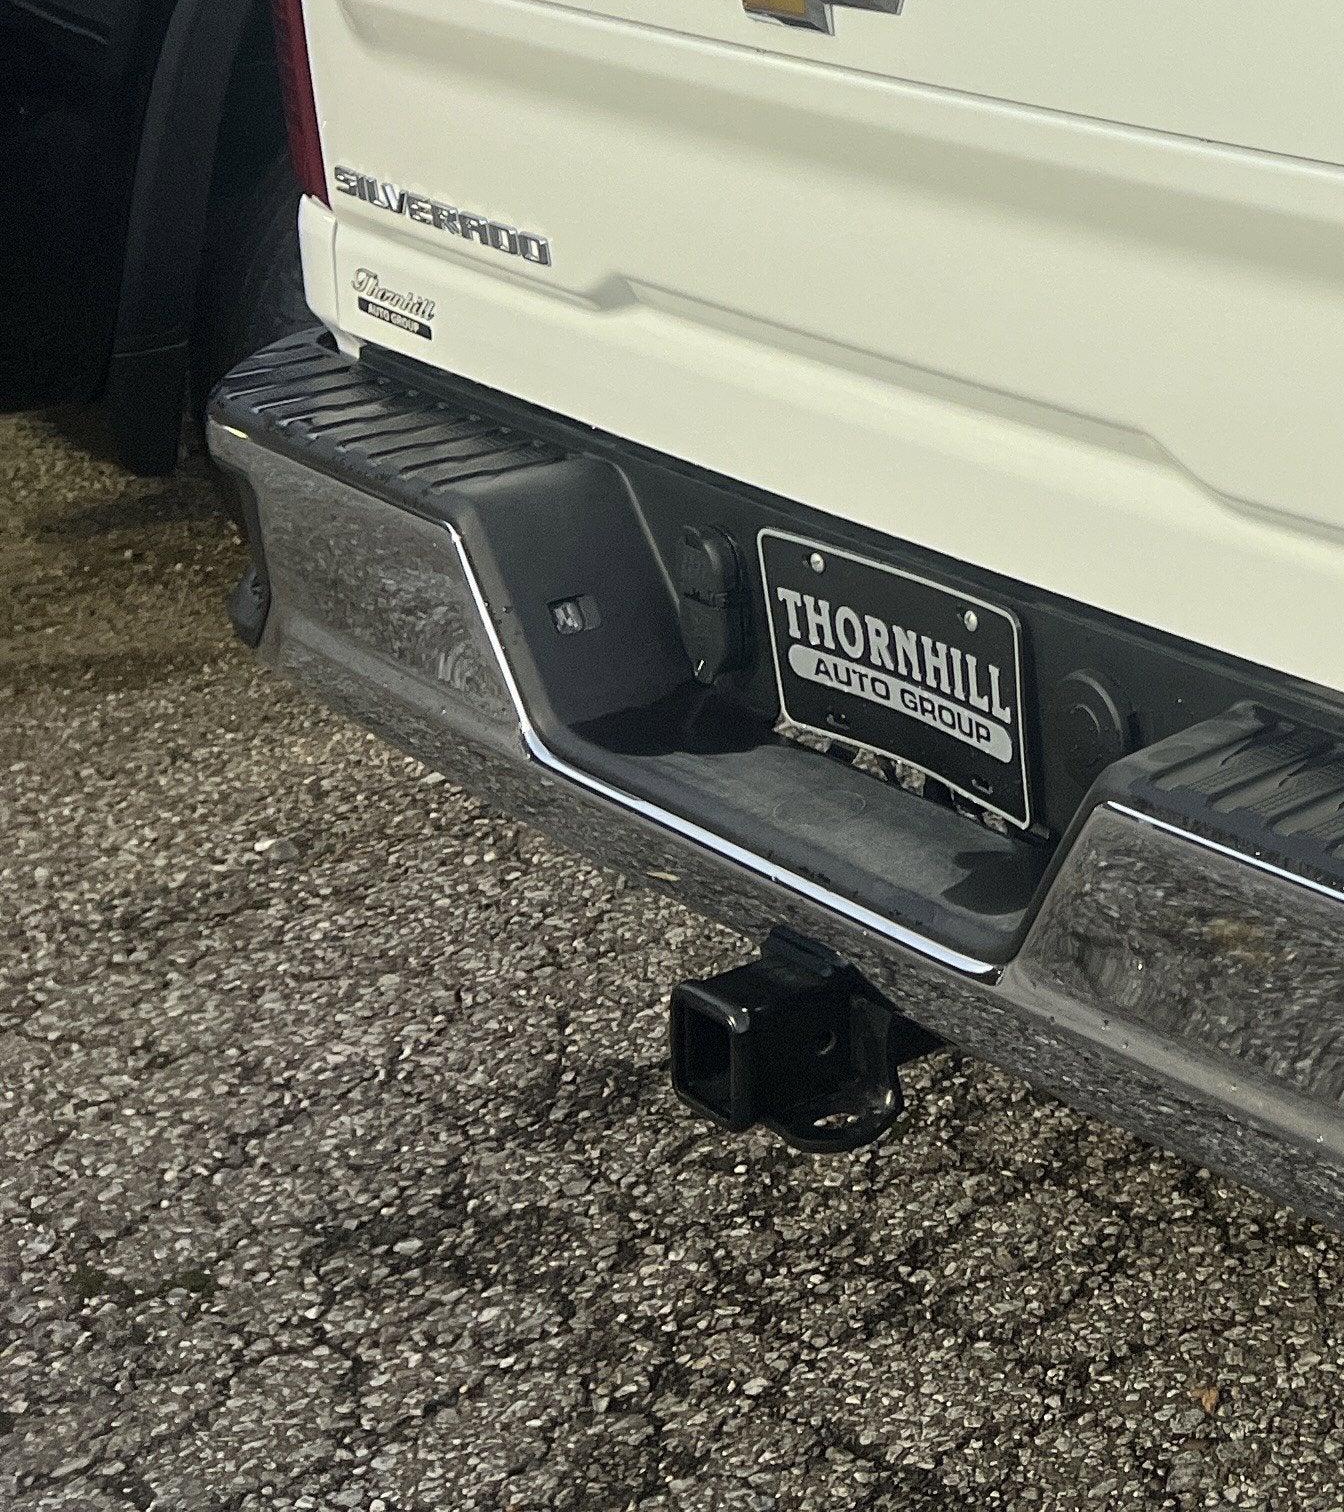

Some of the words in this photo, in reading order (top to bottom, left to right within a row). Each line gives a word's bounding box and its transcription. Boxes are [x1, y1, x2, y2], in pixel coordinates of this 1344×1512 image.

[334, 165, 552, 267] SILVERADO
[351, 268, 436, 321] Thornhill
[367, 303, 390, 324] AUTO
[390, 310, 420, 334] GROUP
[776, 586, 1012, 724] THORNHILL
[814, 657, 891, 701] AUTO
[900, 688, 992, 744] GROUP
